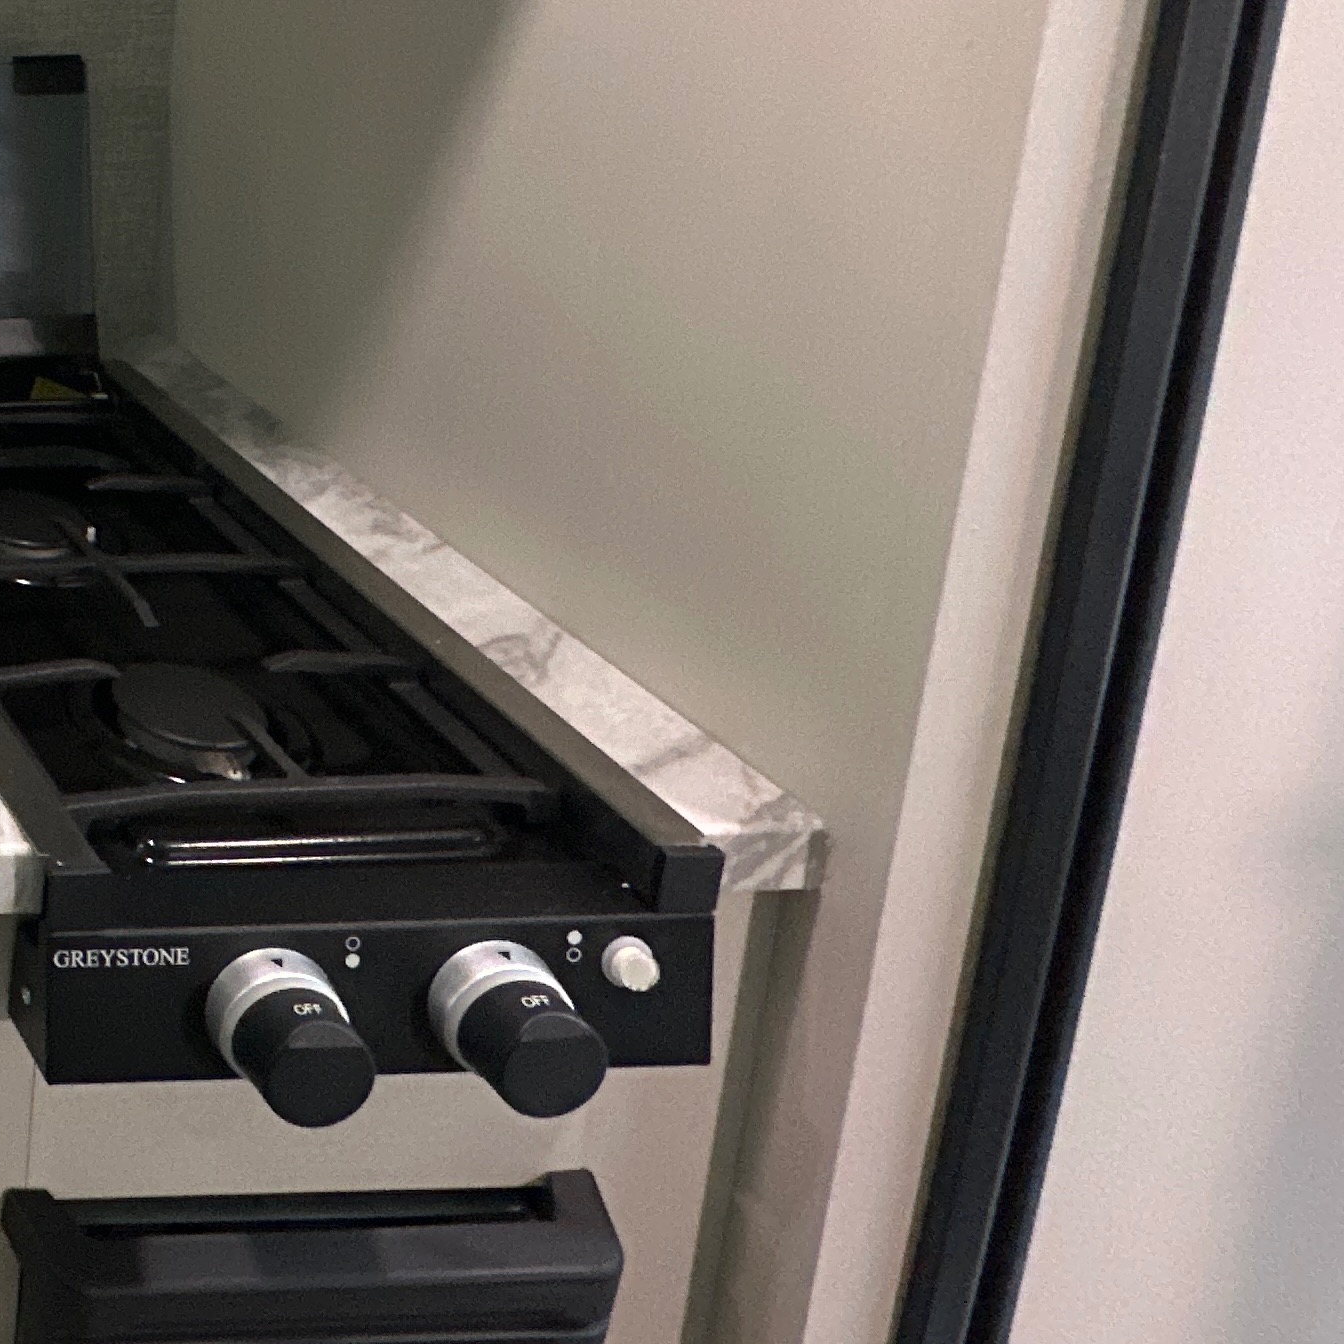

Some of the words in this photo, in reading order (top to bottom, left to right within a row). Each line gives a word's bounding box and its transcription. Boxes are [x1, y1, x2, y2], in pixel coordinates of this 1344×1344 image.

[53, 946, 190, 969] GREYSTONE
[521, 994, 550, 1008] OFF
[293, 1002, 322, 1016] OFF
